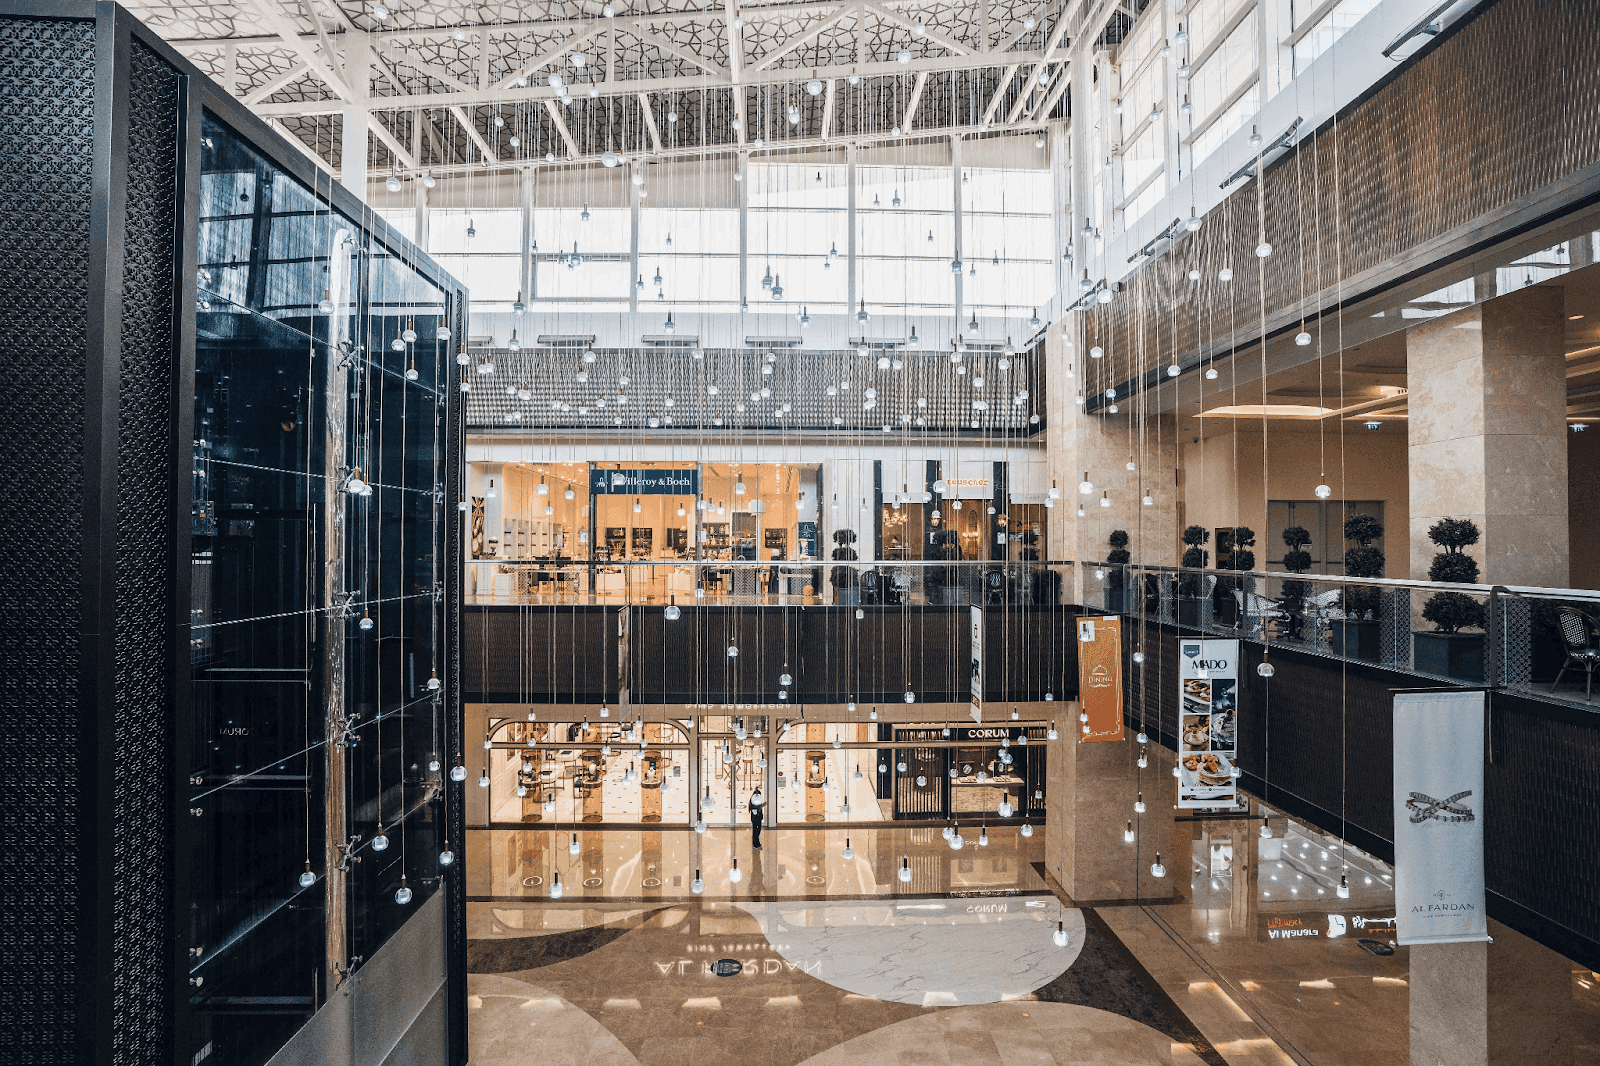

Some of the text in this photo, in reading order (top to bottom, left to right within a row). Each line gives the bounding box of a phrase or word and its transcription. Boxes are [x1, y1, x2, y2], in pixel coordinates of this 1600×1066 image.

[658, 477, 666, 486] &
[666, 476, 690, 486] Boch
[946, 478, 989, 487] teuscher
[1192, 659, 1228, 669] MADO
[1088, 676, 1113, 684] DINING
[967, 728, 1010, 738] CORUM
[1411, 903, 1475, 913] AL FARDAN
